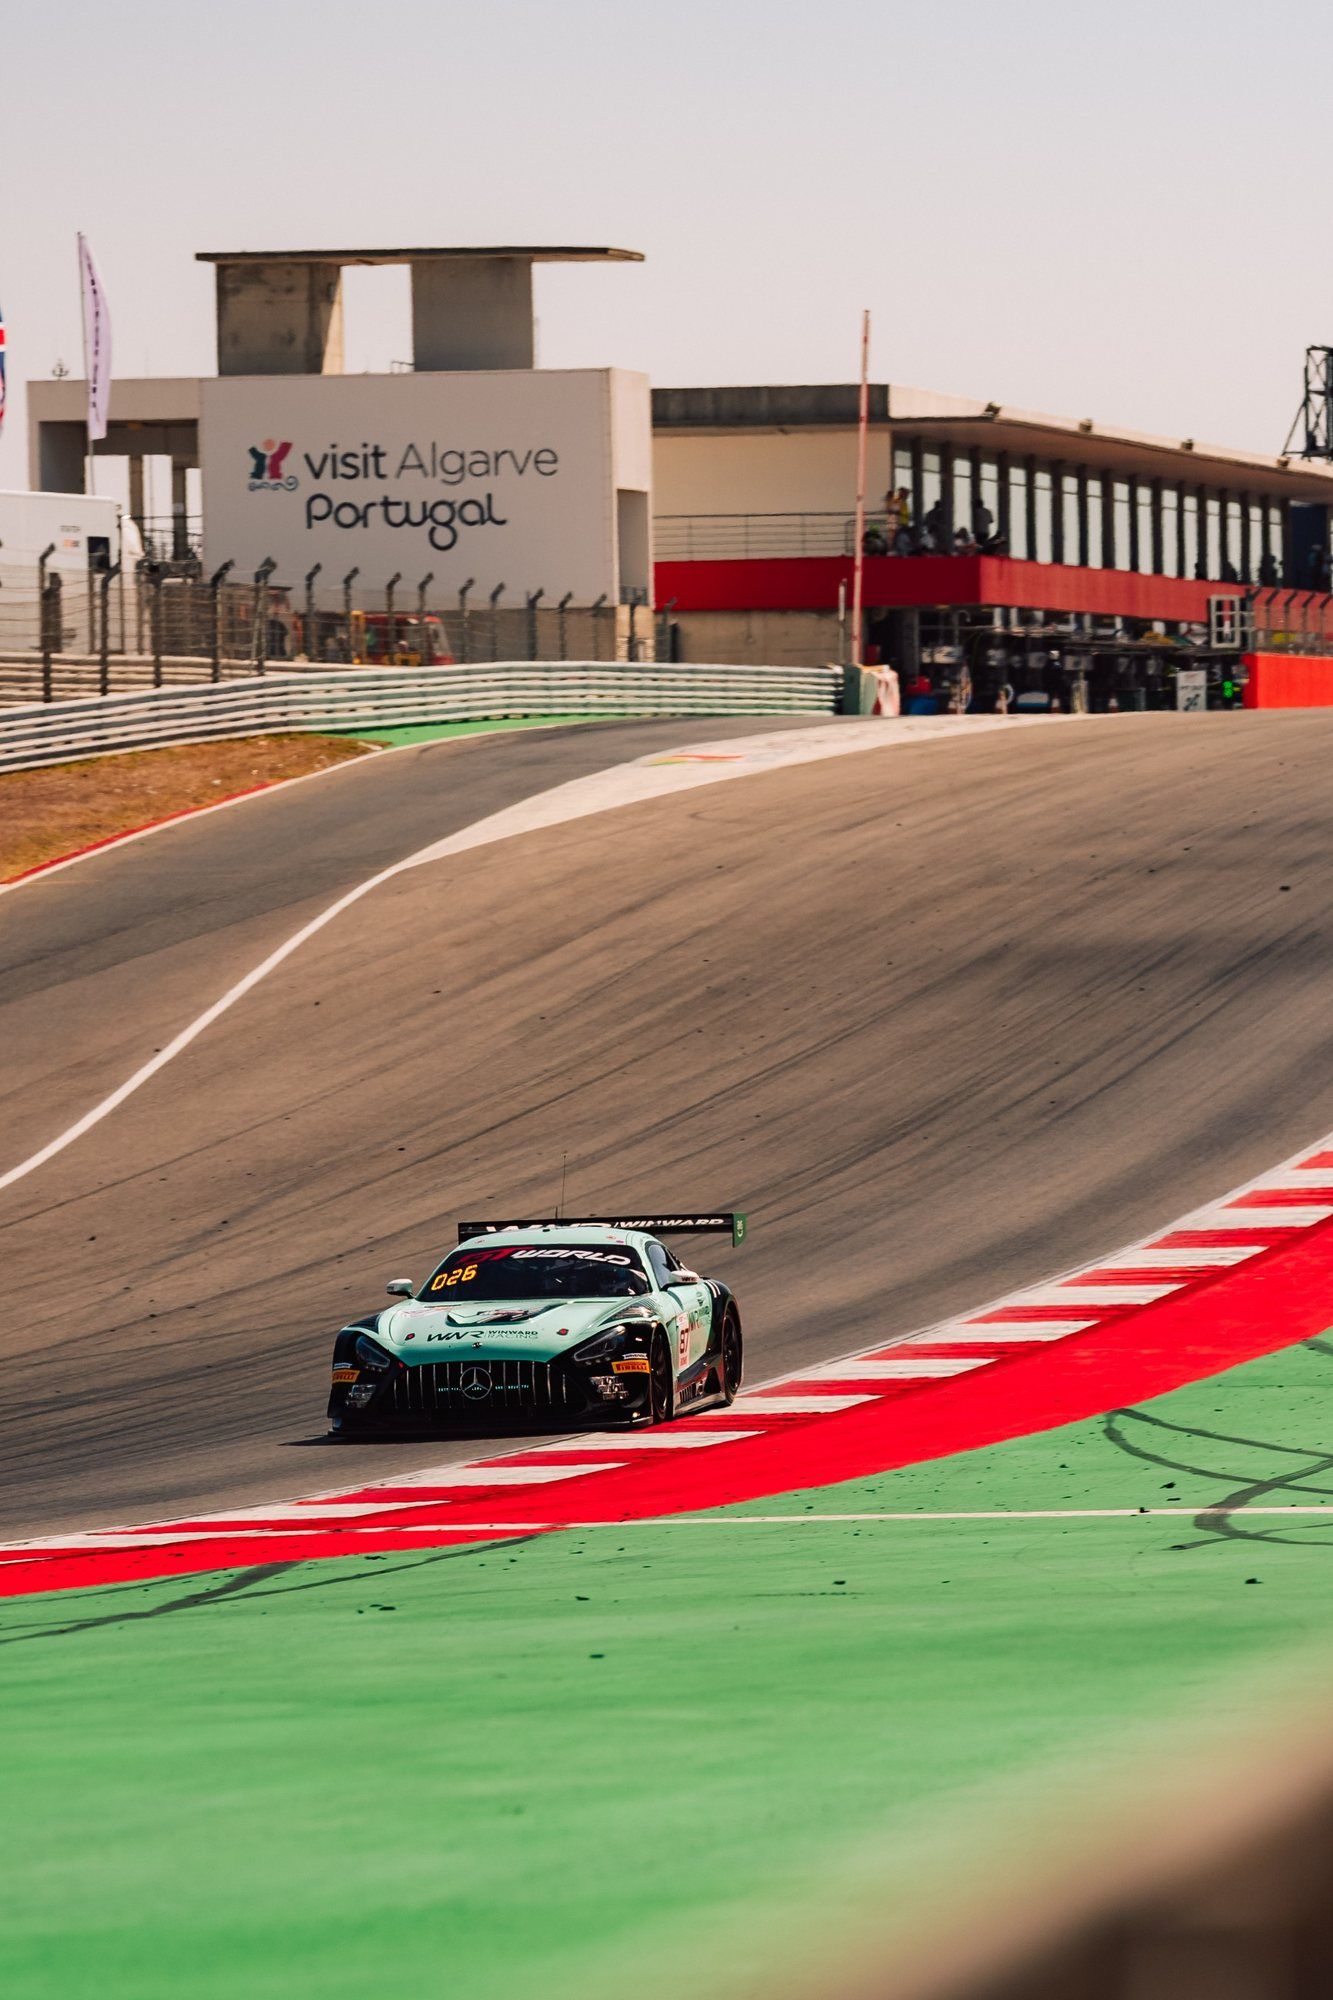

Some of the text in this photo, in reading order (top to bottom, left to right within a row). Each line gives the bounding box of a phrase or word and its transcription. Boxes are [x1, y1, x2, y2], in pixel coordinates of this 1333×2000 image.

[304, 441, 559, 486] visit Algarve
[305, 493, 507, 551] Portugal
[510, 1249, 631, 1266] WORLD
[431, 1264, 478, 1290] 026
